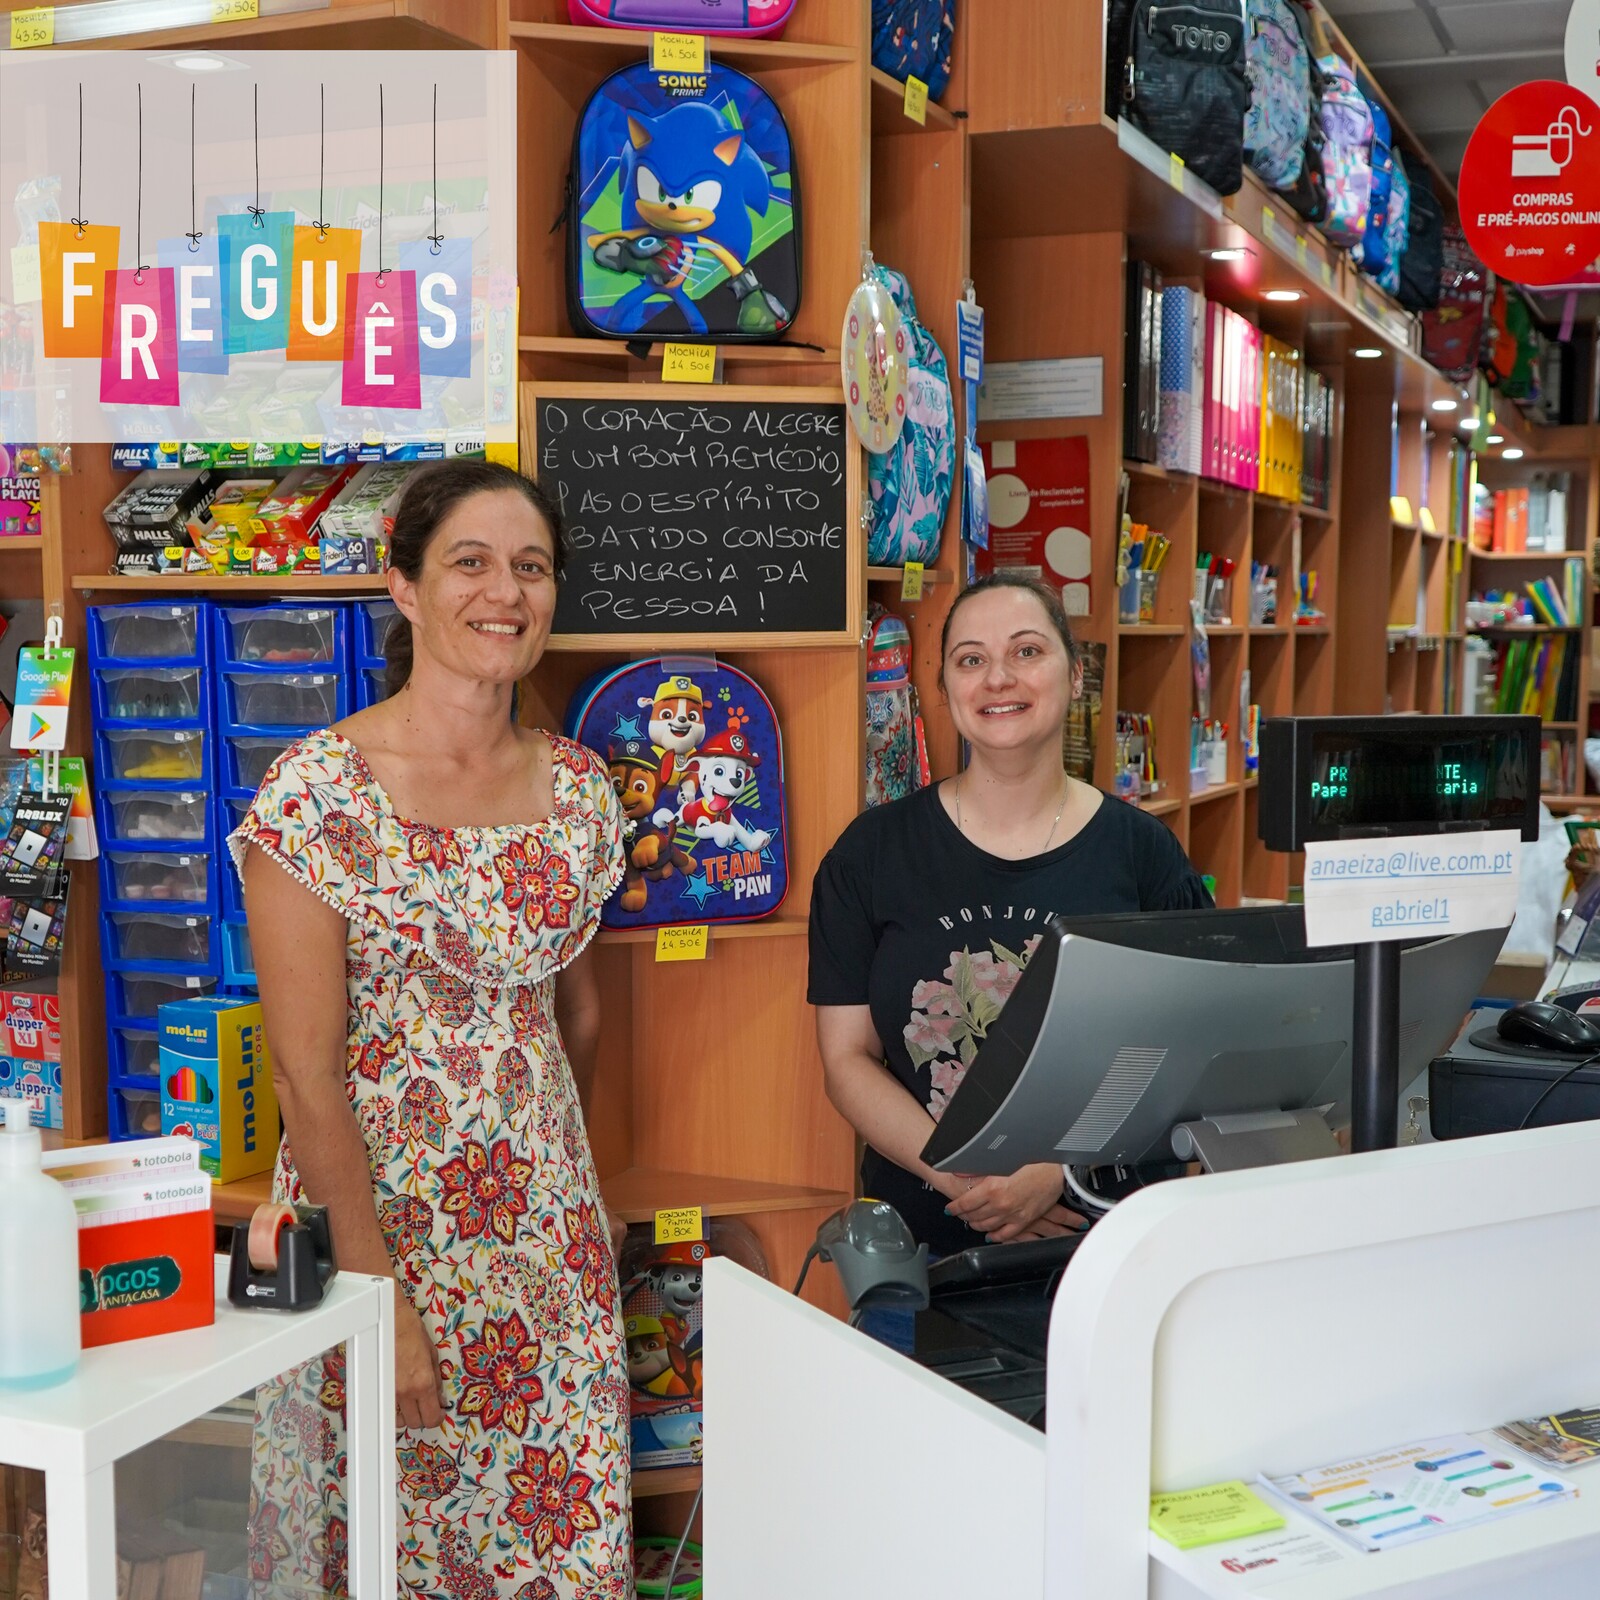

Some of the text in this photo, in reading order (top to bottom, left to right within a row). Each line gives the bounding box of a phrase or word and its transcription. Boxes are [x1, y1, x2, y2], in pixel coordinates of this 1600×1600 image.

[15, 28, 47, 42] 43.50
[661, 48, 697, 59] 14.50€
[658, 74, 707, 88] SONIC
[672, 88, 705, 97] PRIME
[1513, 192, 1574, 207] COMPRAS
[1477, 213, 1487, 227] E
[1487, 210, 1560, 226] PRÉ-PAGOS
[1516, 247, 1545, 256] payshop
[545, 403, 841, 445] O CORAÇÃO ALEGRE
[543, 439, 559, 469] É
[572, 445, 620, 470] UM
[628, 444, 696, 470] BOM
[722, 522, 842, 549] CONSOME
[348, 541, 363, 553] 60
[322, 549, 347, 561] Trident
[757, 560, 809, 584] DA
[580, 590, 738, 620] PESSOA
[20, 670, 69, 685] Google Play
[16, 809, 64, 822] ROBLOX
[702, 852, 761, 884] TEAM
[1310, 850, 1513, 879] anaeiza@live.com.pt
[733, 874, 772, 900] PAW
[1371, 898, 1450, 927] gabriel1
[661, 939, 702, 951] 14.50€
[6, 1013, 44, 1031] dipper
[18, 1032, 35, 1045] XL
[14, 1078, 53, 1096] dipper
[163, 1102, 175, 1116] 12
[197, 1130, 218, 1140] PLUS
[144, 1151, 192, 1167] totobola
[155, 1184, 204, 1200] totobola
